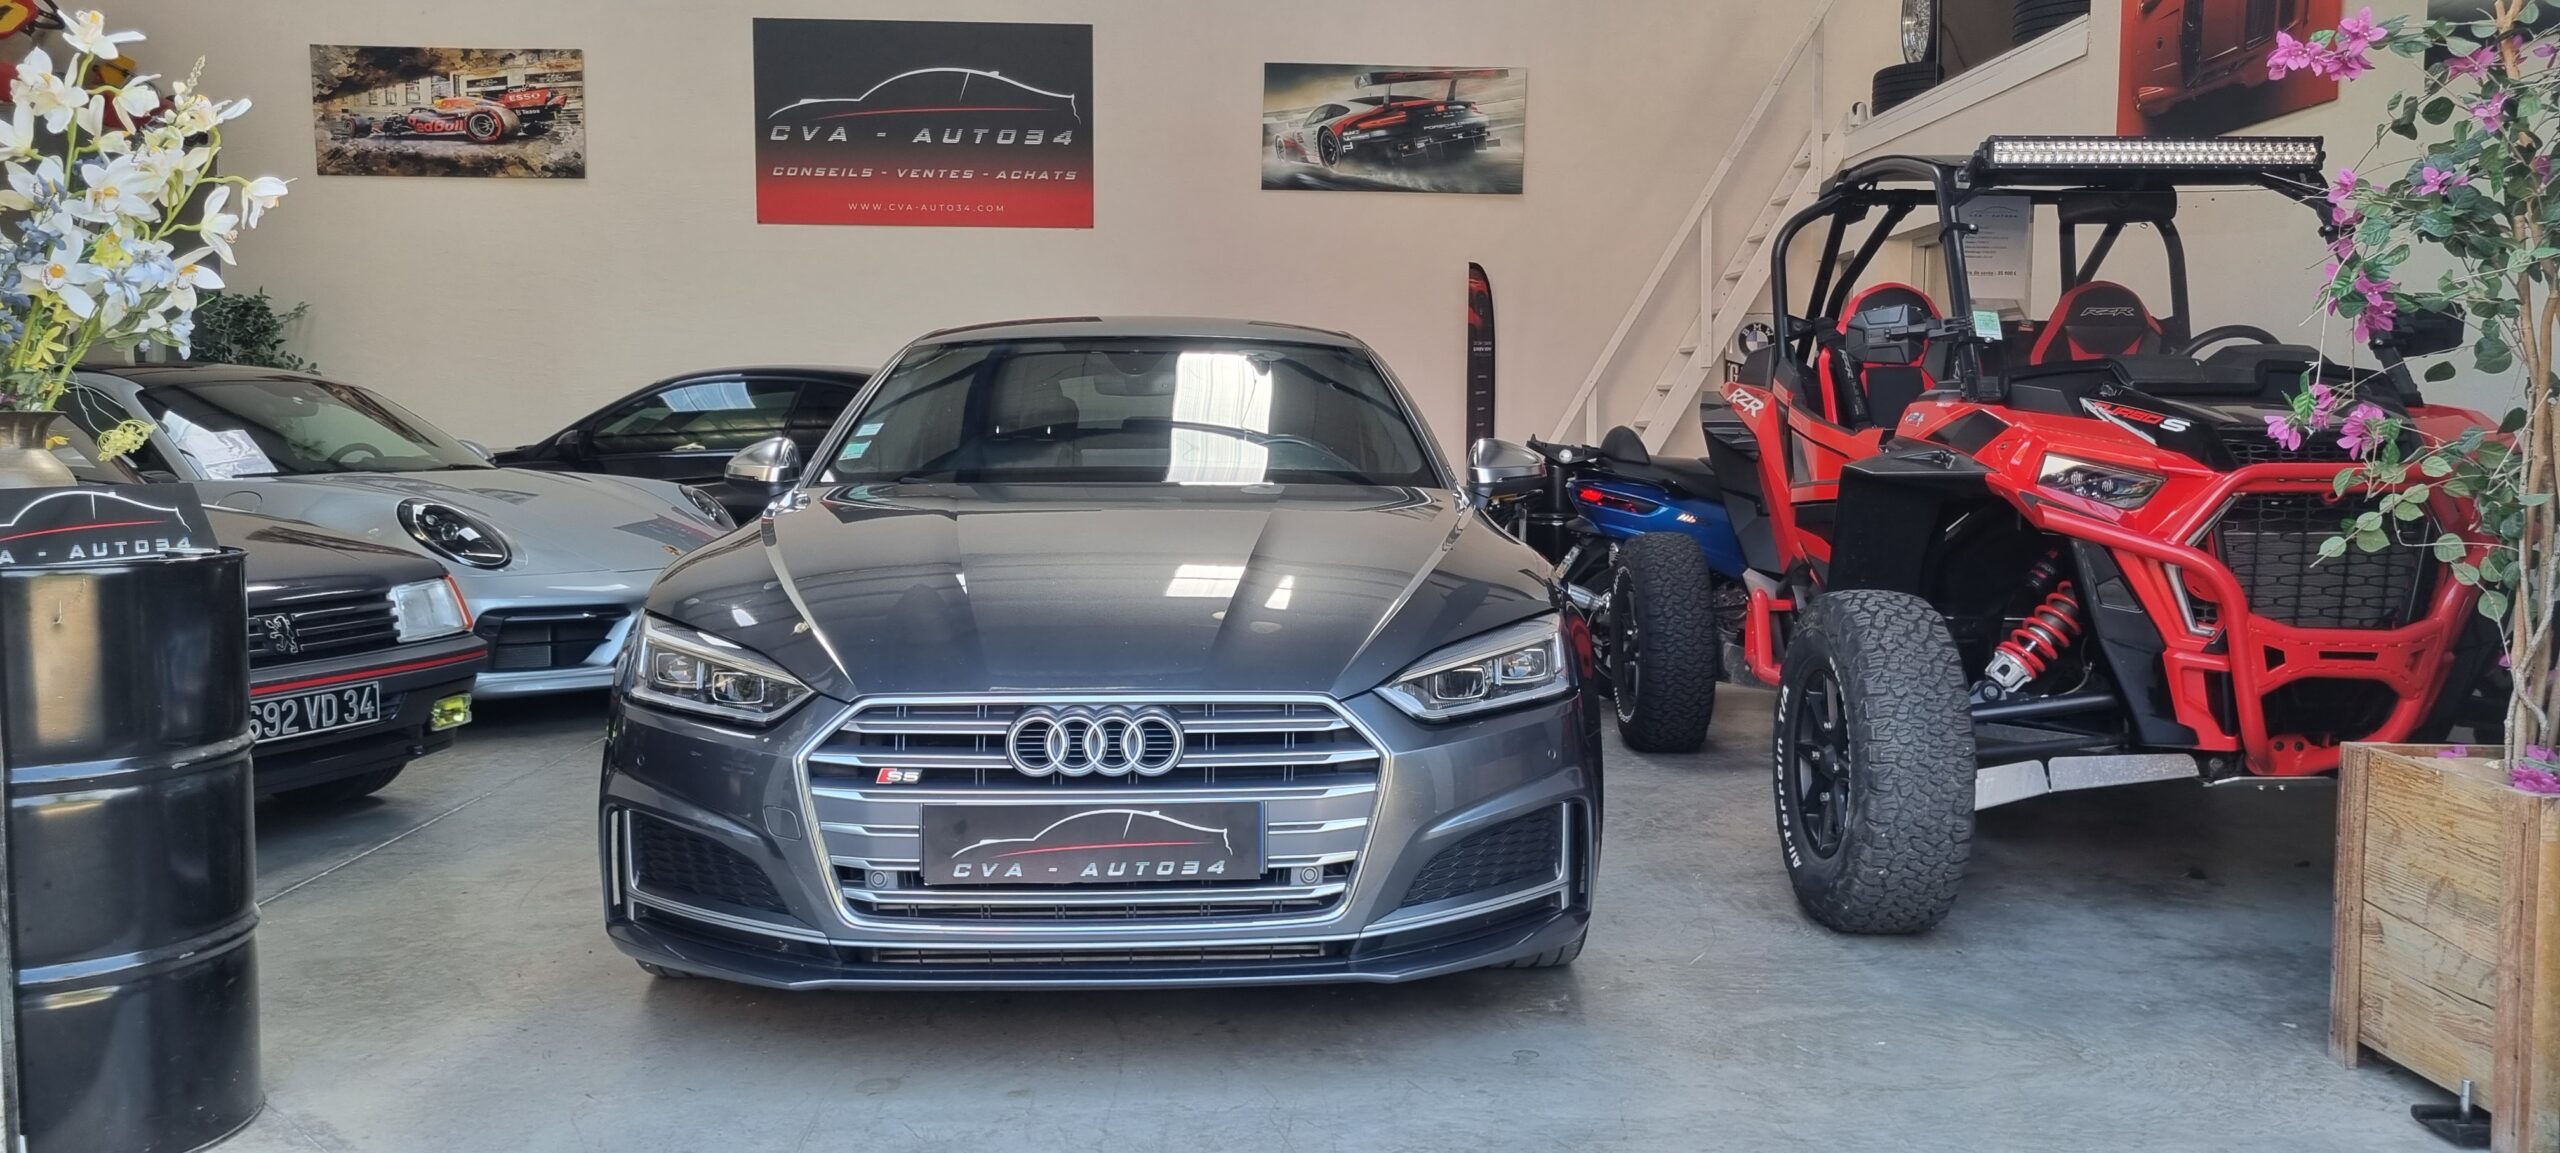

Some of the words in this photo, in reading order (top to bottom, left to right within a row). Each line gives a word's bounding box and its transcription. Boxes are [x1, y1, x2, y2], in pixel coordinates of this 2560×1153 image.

[509, 92, 541, 102] ESSO
[770, 125, 848, 142] CVA
[912, 128, 1073, 145] AUTO34
[772, 166, 873, 178] CONSEILS
[897, 168, 974, 180] VENTES
[996, 170, 1078, 181] ACHATS
[848, 202, 1004, 213] WWW.CVA-AUTO34.COM
[2080, 306, 2135, 317] RZR
[1742, 323, 1774, 337] BMW
[1727, 387, 1765, 418] RZR
[2159, 418, 2191, 433] S
[69, 536, 192, 559] AUTO34
[250, 699, 299, 739] 692
[304, 693, 338, 729] VD
[344, 686, 375, 722] 34
[884, 770, 920, 783] S5
[952, 862, 1023, 879] CVA
[1080, 859, 1226, 878] AUTO34
